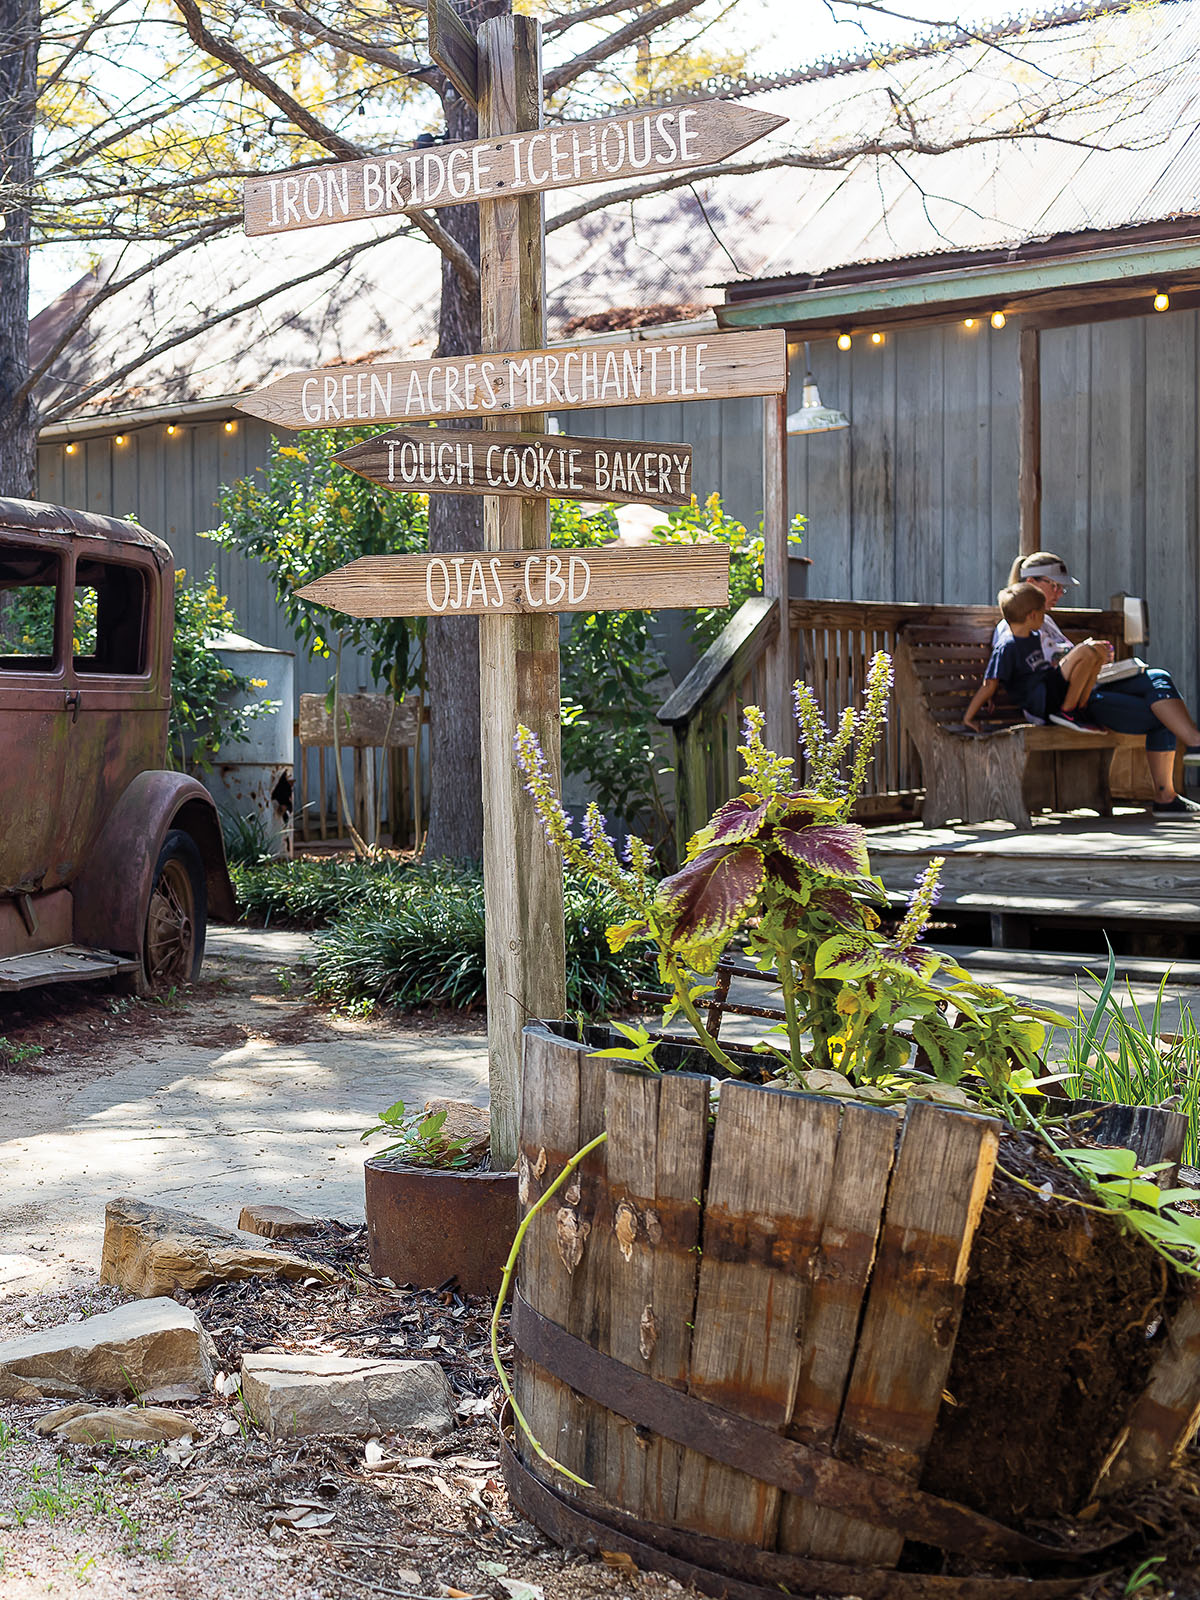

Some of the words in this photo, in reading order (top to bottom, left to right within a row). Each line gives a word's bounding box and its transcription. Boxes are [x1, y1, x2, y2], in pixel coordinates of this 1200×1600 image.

[264, 168, 349, 227] IRON
[362, 145, 491, 212] BRIDGE
[508, 110, 702, 188] ICEHOUSE
[301, 373, 394, 423] GREEN
[404, 361, 498, 416] ACRES
[507, 343, 709, 408] MERCHANTILE
[382, 439, 475, 487] TOUGH
[485, 443, 584, 491] COOKIE
[594, 450, 691, 495] BAKERY
[426, 557, 505, 613] OJAS
[524, 555, 591, 607] CBD
